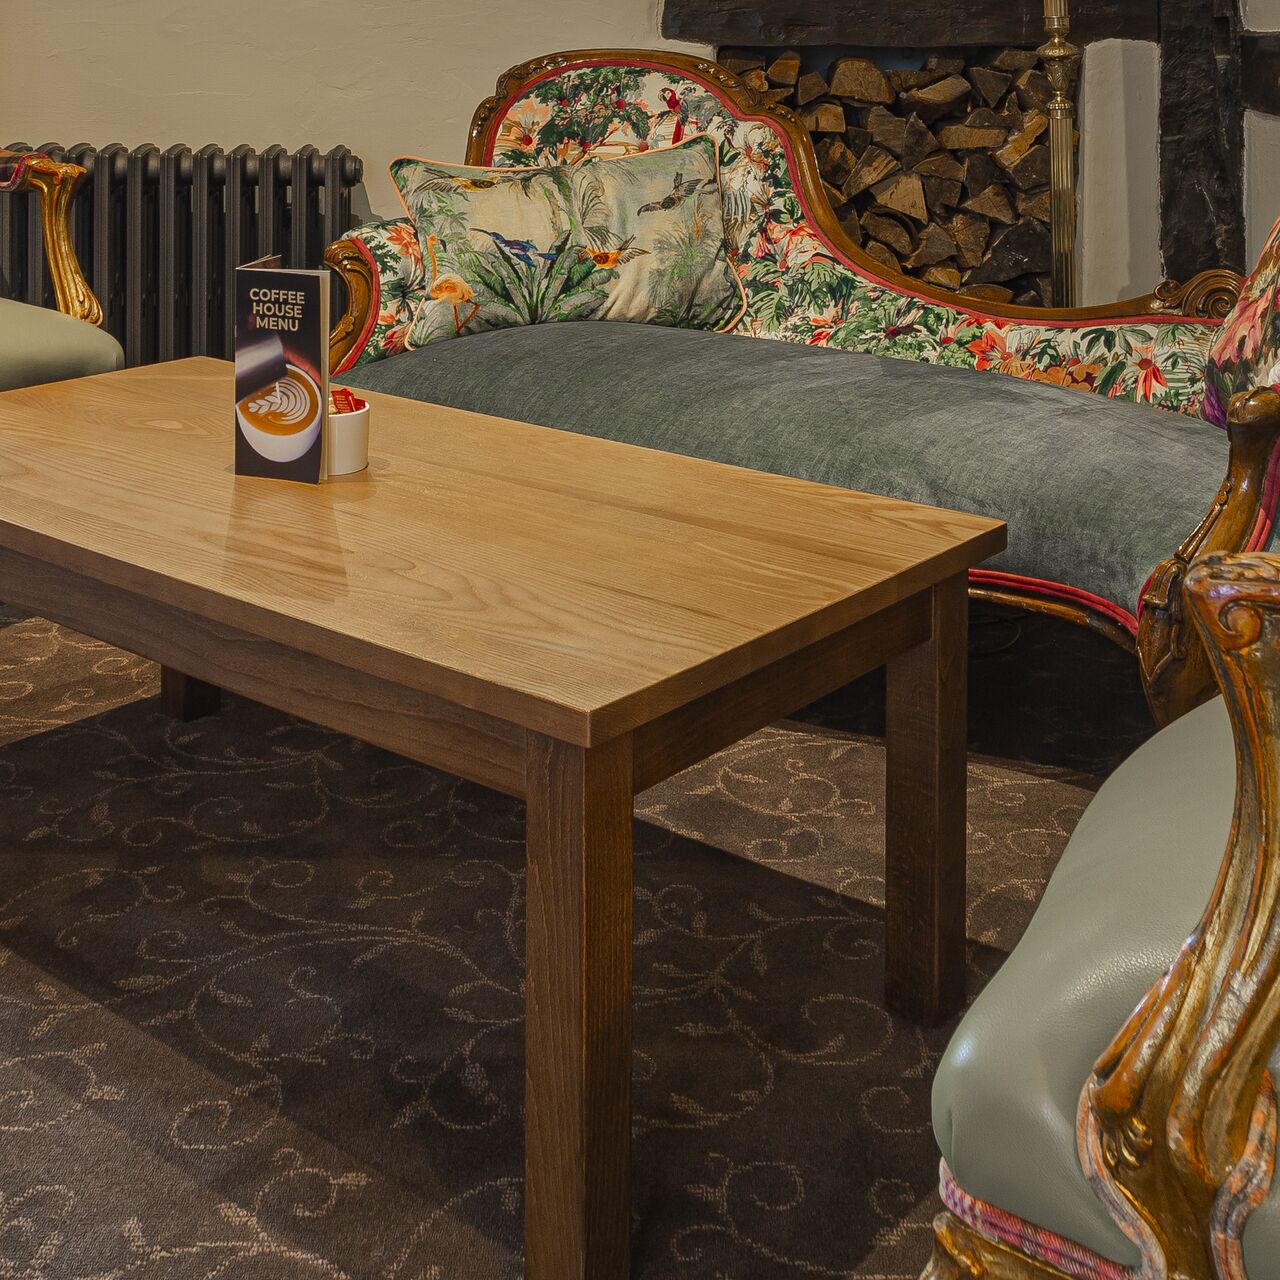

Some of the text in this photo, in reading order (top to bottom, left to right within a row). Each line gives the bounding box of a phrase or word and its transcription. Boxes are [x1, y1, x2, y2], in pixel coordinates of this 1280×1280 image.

[250, 287, 305, 304] COFFEE
[253, 302, 302, 318] HOUSE
[256, 316, 299, 331] MENU
